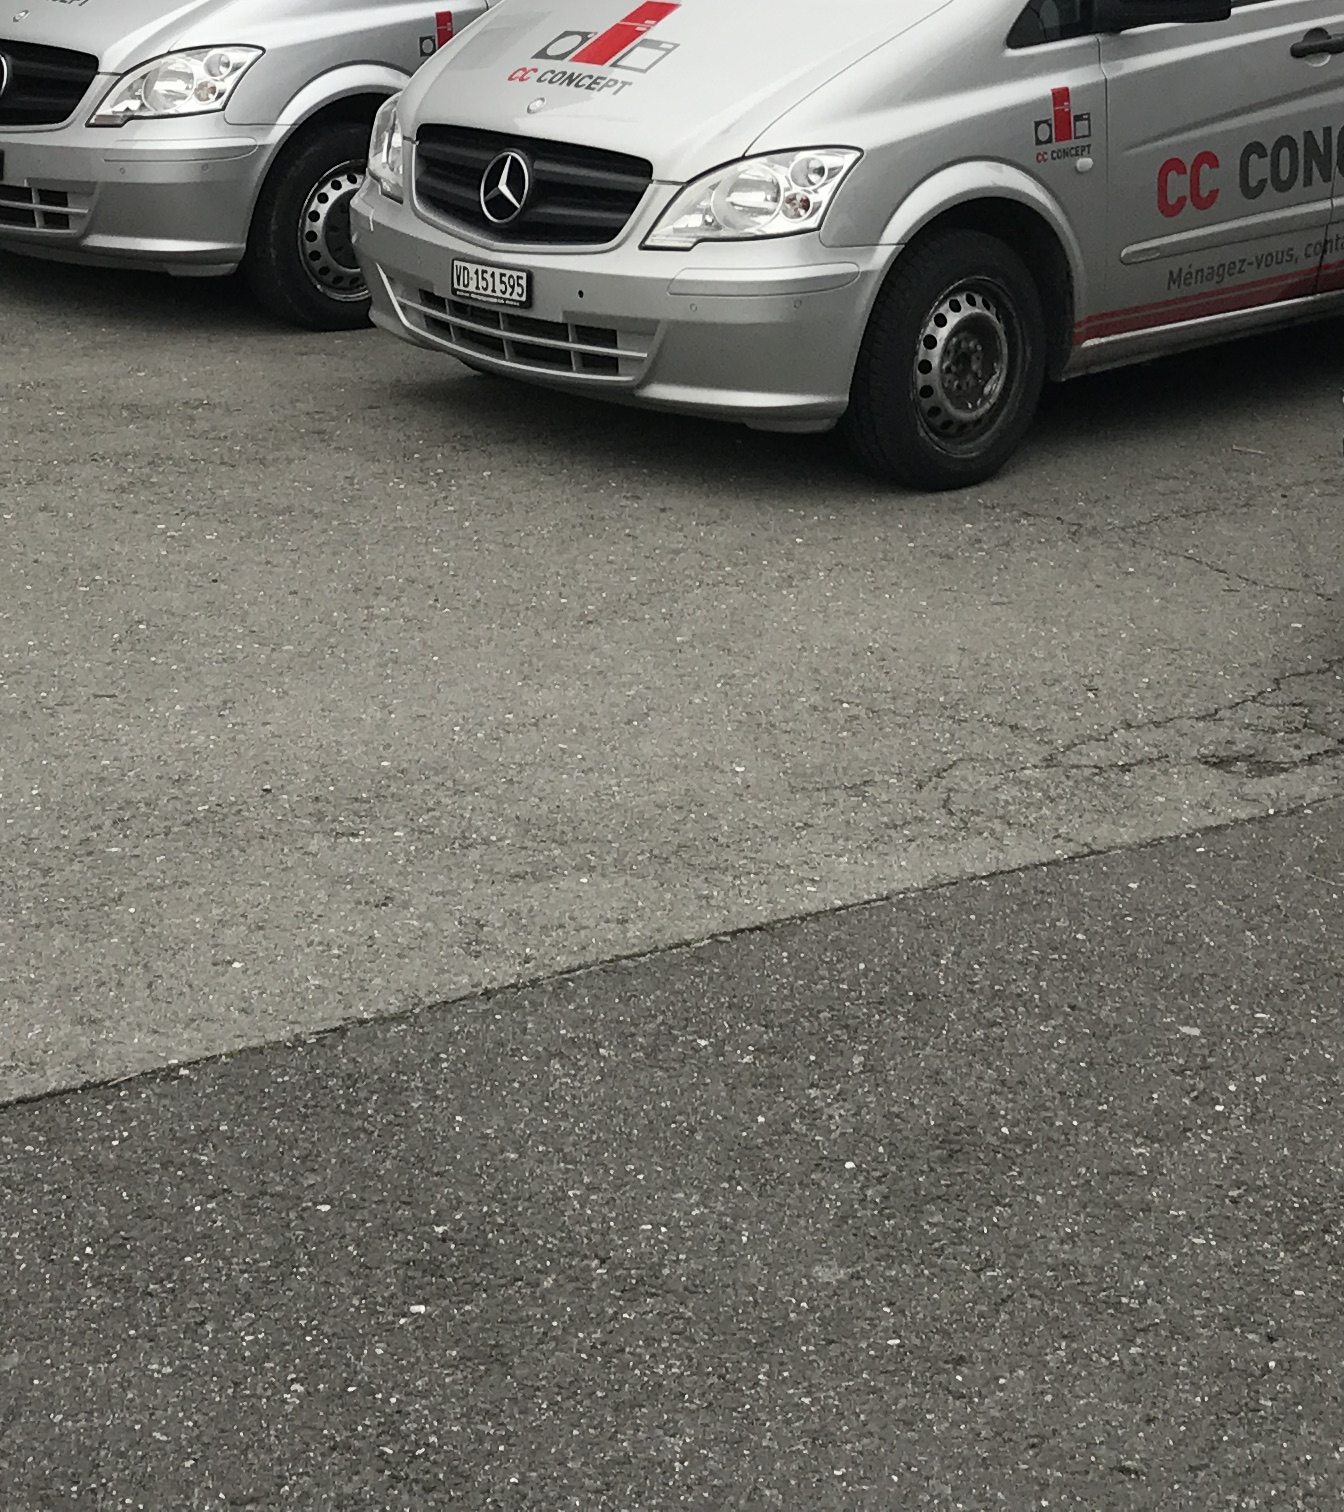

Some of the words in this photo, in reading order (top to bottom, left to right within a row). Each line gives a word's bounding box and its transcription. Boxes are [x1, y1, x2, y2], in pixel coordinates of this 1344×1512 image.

[507, 67, 538, 83] CC
[536, 69, 633, 96] CONCEPT
[1036, 151, 1048, 163] CC
[1050, 144, 1092, 161] CONCEPT
[1157, 150, 1220, 218] CC
